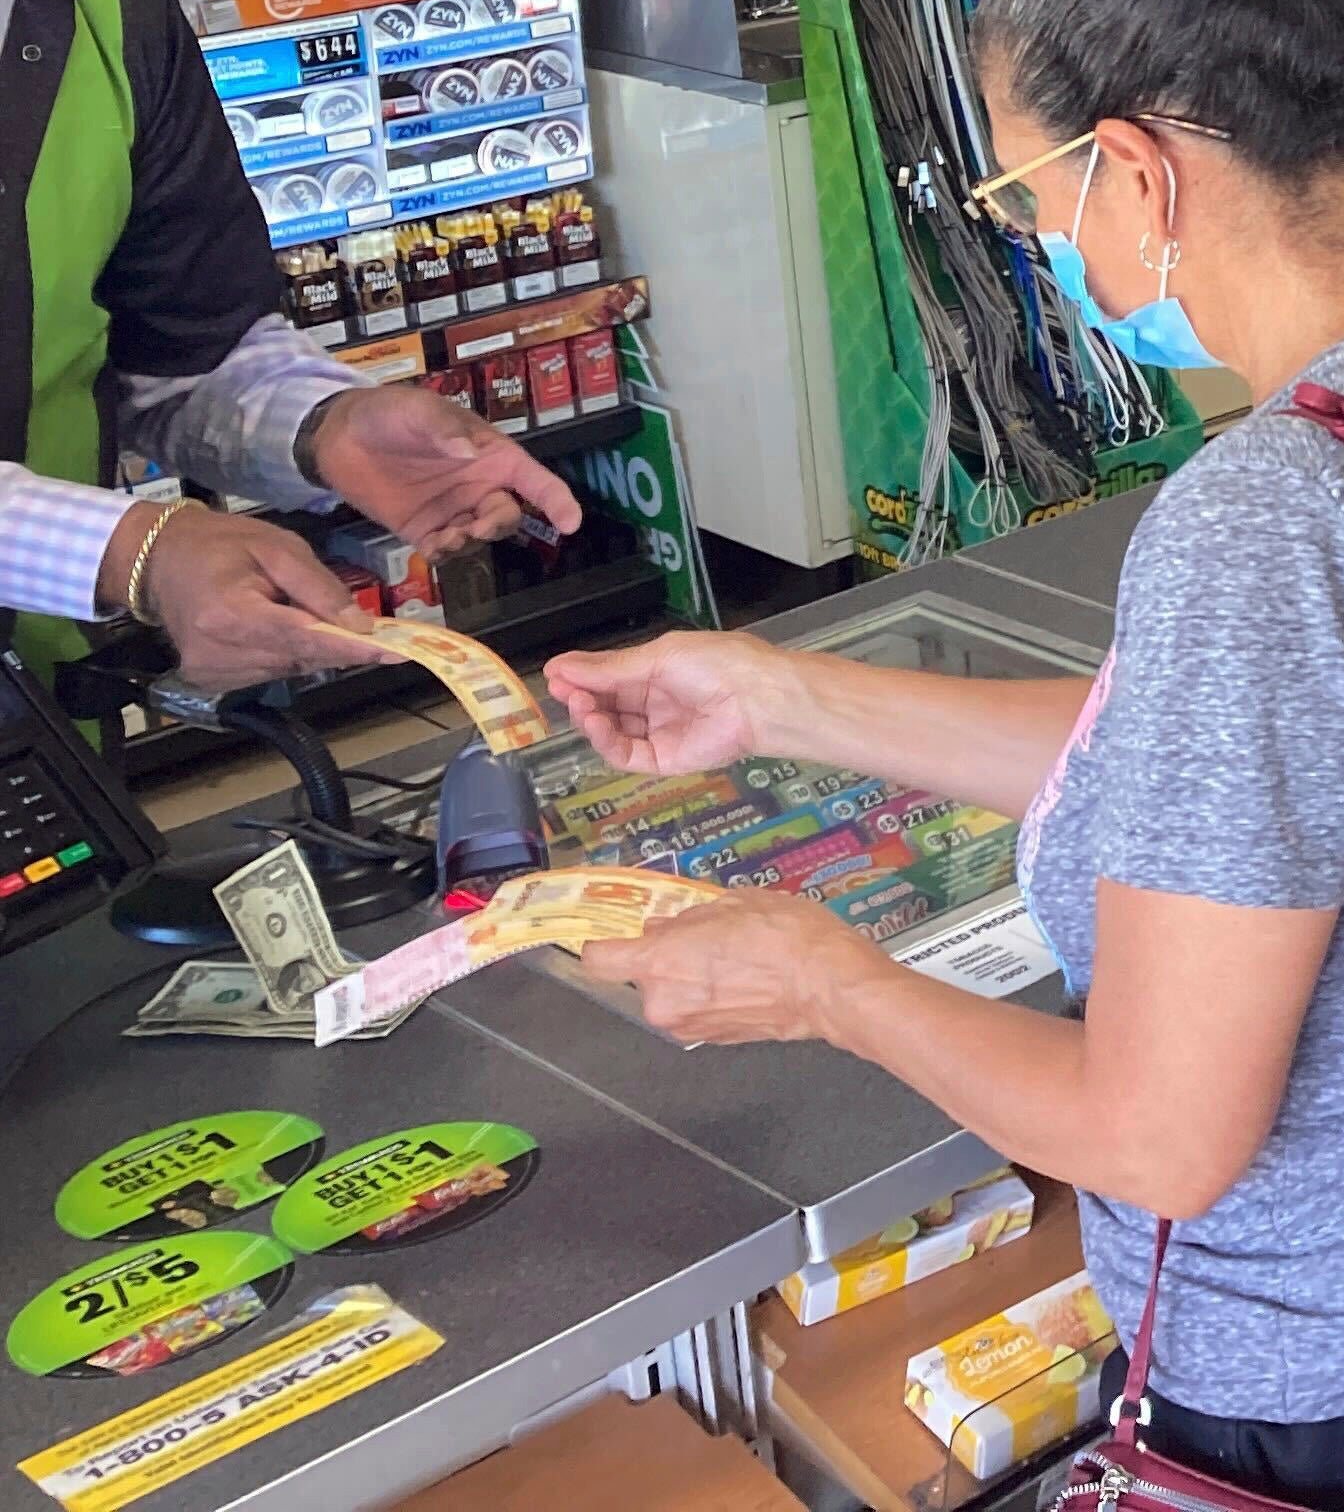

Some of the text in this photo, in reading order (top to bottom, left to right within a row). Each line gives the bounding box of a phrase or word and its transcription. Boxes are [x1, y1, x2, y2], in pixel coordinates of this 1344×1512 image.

[431, 6, 461, 23] ZYN
[382, 14, 412, 39] ZYN
[383, 47, 420, 65] ZYN
[446, 78, 473, 100] ZYN
[394, 120, 432, 138] ZYN
[400, 193, 436, 212] ZYN
[773, 763, 797, 780] 15
[818, 777, 841, 794] 19
[859, 791, 883, 808] 23
[586, 803, 612, 820] 10
[904, 811, 925, 828] 27
[625, 820, 650, 836] 14
[946, 827, 970, 844] 31
[672, 830, 697, 850] 18
[711, 850, 739, 867] 22
[754, 869, 781, 887] 26
[180, 1131, 237, 1158] $1
[392, 1140, 455, 1167] $1
[101, 1152, 174, 1187] BUY 1
[117, 1168, 170, 1195] GET
[314, 1175, 365, 1209] BUY
[370, 1160, 386, 1179] 1
[327, 1187, 381, 1210] GET
[65, 1253, 201, 1324] 2/$5
[83, 1408, 226, 1481] 1-800-5
[237, 1328, 392, 1410] ASK-4-ID
